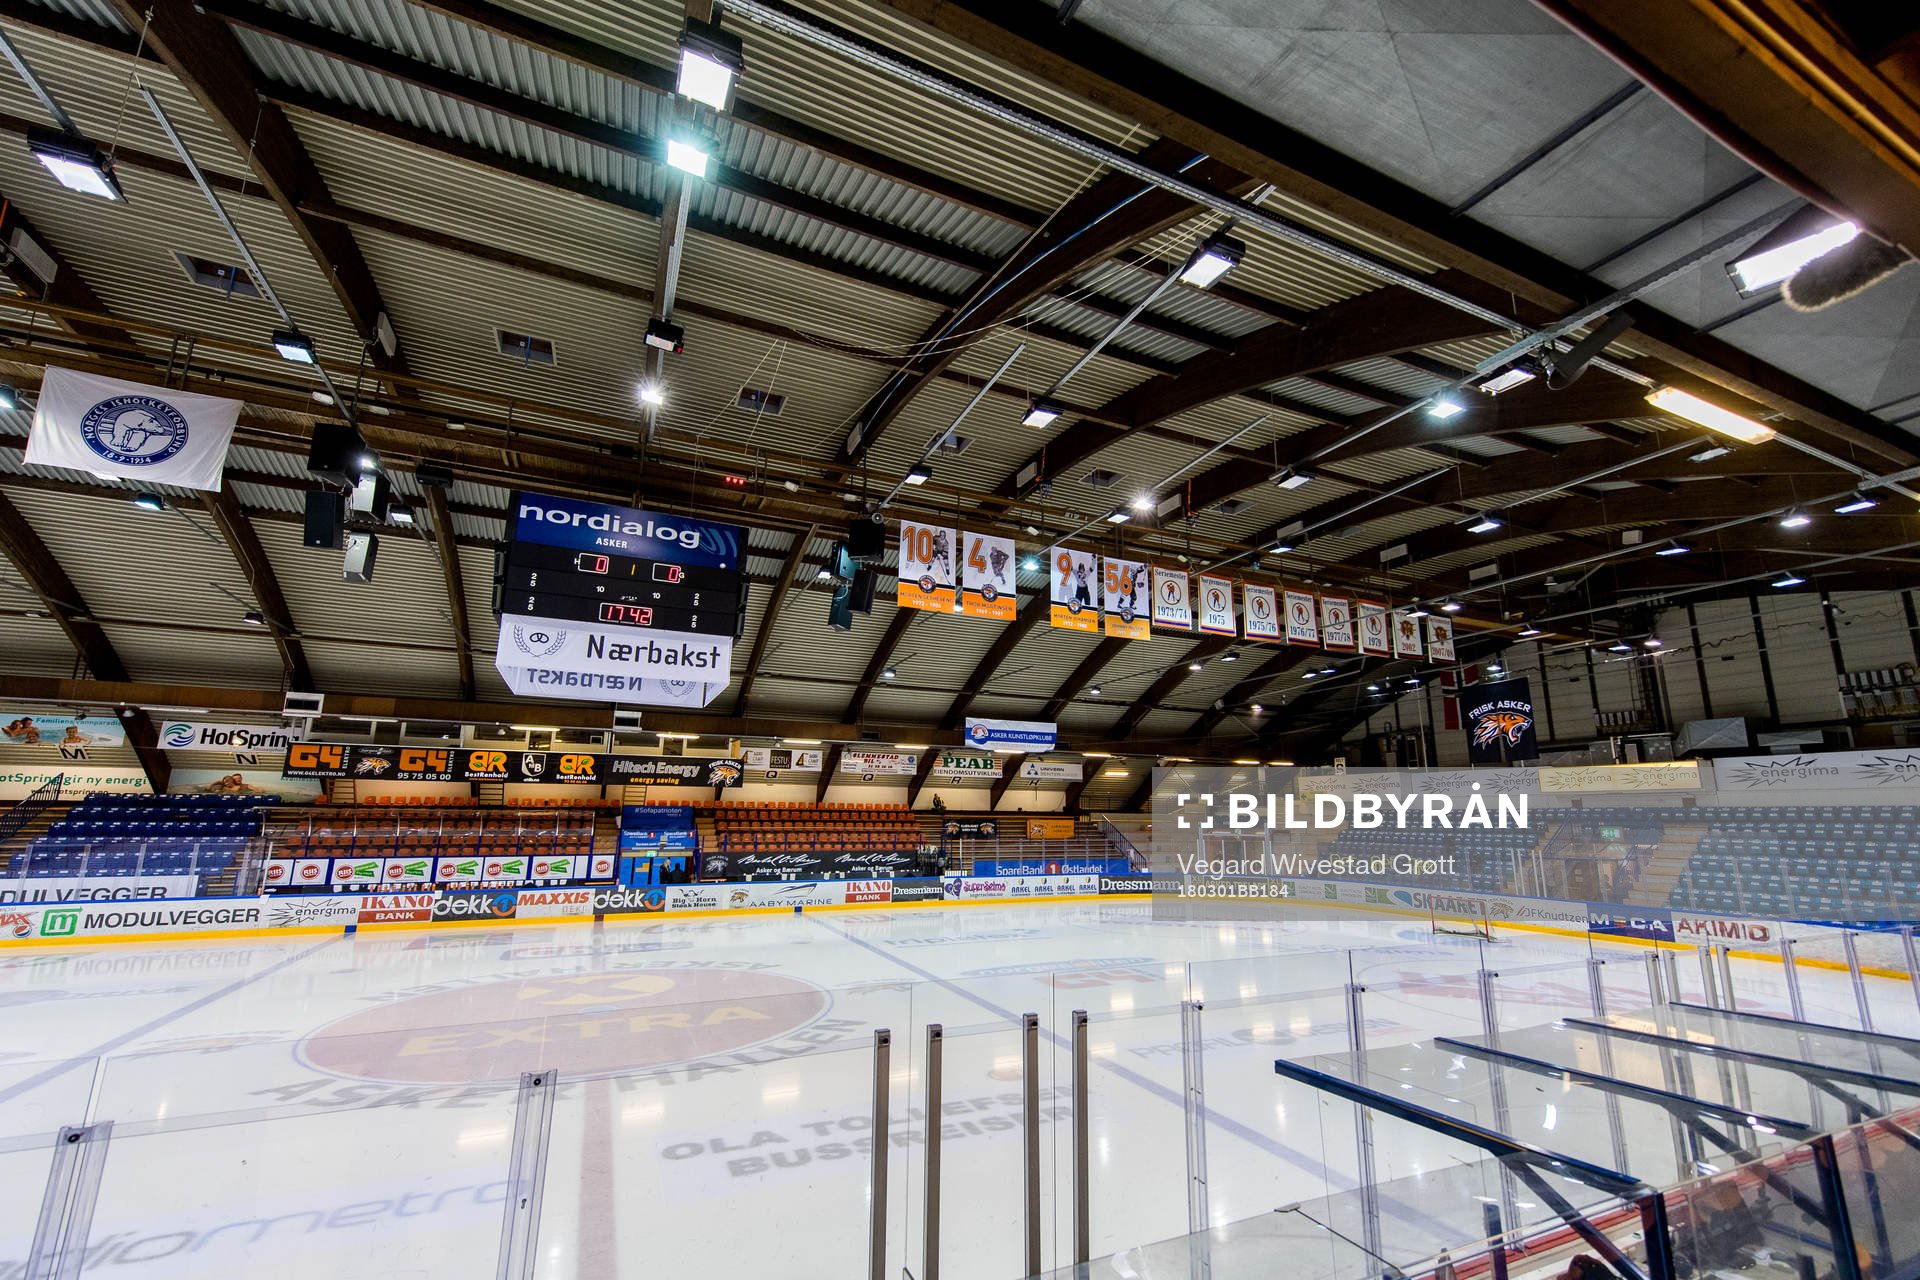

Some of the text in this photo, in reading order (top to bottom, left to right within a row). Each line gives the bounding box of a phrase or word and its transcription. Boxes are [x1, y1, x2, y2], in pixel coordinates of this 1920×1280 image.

[519, 504, 701, 549] nordialog
[595, 536, 628, 550] ASKER
[902, 525, 934, 565] 10
[967, 537, 986, 574] 4
[1056, 552, 1073, 586] 9
[1105, 563, 1134, 596] 56
[1157, 605, 1188, 620] 1973/74
[1208, 613, 1226, 626] 1975
[1248, 620, 1277, 632] 1975/76
[1289, 625, 1316, 639] 1976/77
[586, 633, 721, 669] Nærbakst
[1468, 700, 1532, 720] FRISK ASKER
[60, 747, 87, 760] M
[236, 754, 258, 765] N
[612, 760, 701, 778] Hitech Energy
[941, 757, 995, 770] PEAB
[1564, 773, 1612, 785] energima
[1643, 770, 1698, 782] energima
[1761, 767, 1840, 779] energima
[0, 773, 60, 788] otSprin
[64, 774, 86, 787] gir
[86, 776, 103, 788] ny
[629, 776, 680, 785] energy saving
[1365, 781, 1401, 791] energima
[996, 864, 1045, 876] SpareBank
[1061, 864, 1104, 875] Østlandet
[846, 881, 891, 893] IKANO
[893, 886, 943, 896] Dressmann
[1100, 877, 1181, 894] Dressmann
[360, 894, 434, 910] IKANO
[517, 891, 590, 906] MAXXIS
[750, 898, 833, 908] AABY MARINE
[855, 893, 881, 901] BANK
[295, 905, 357, 918] energima
[375, 911, 415, 920] BANK
[83, 908, 261, 930] MODULVEGGER
[397, 1005, 774, 1058] EXTRA
[660, 1129, 790, 1161] OLA
